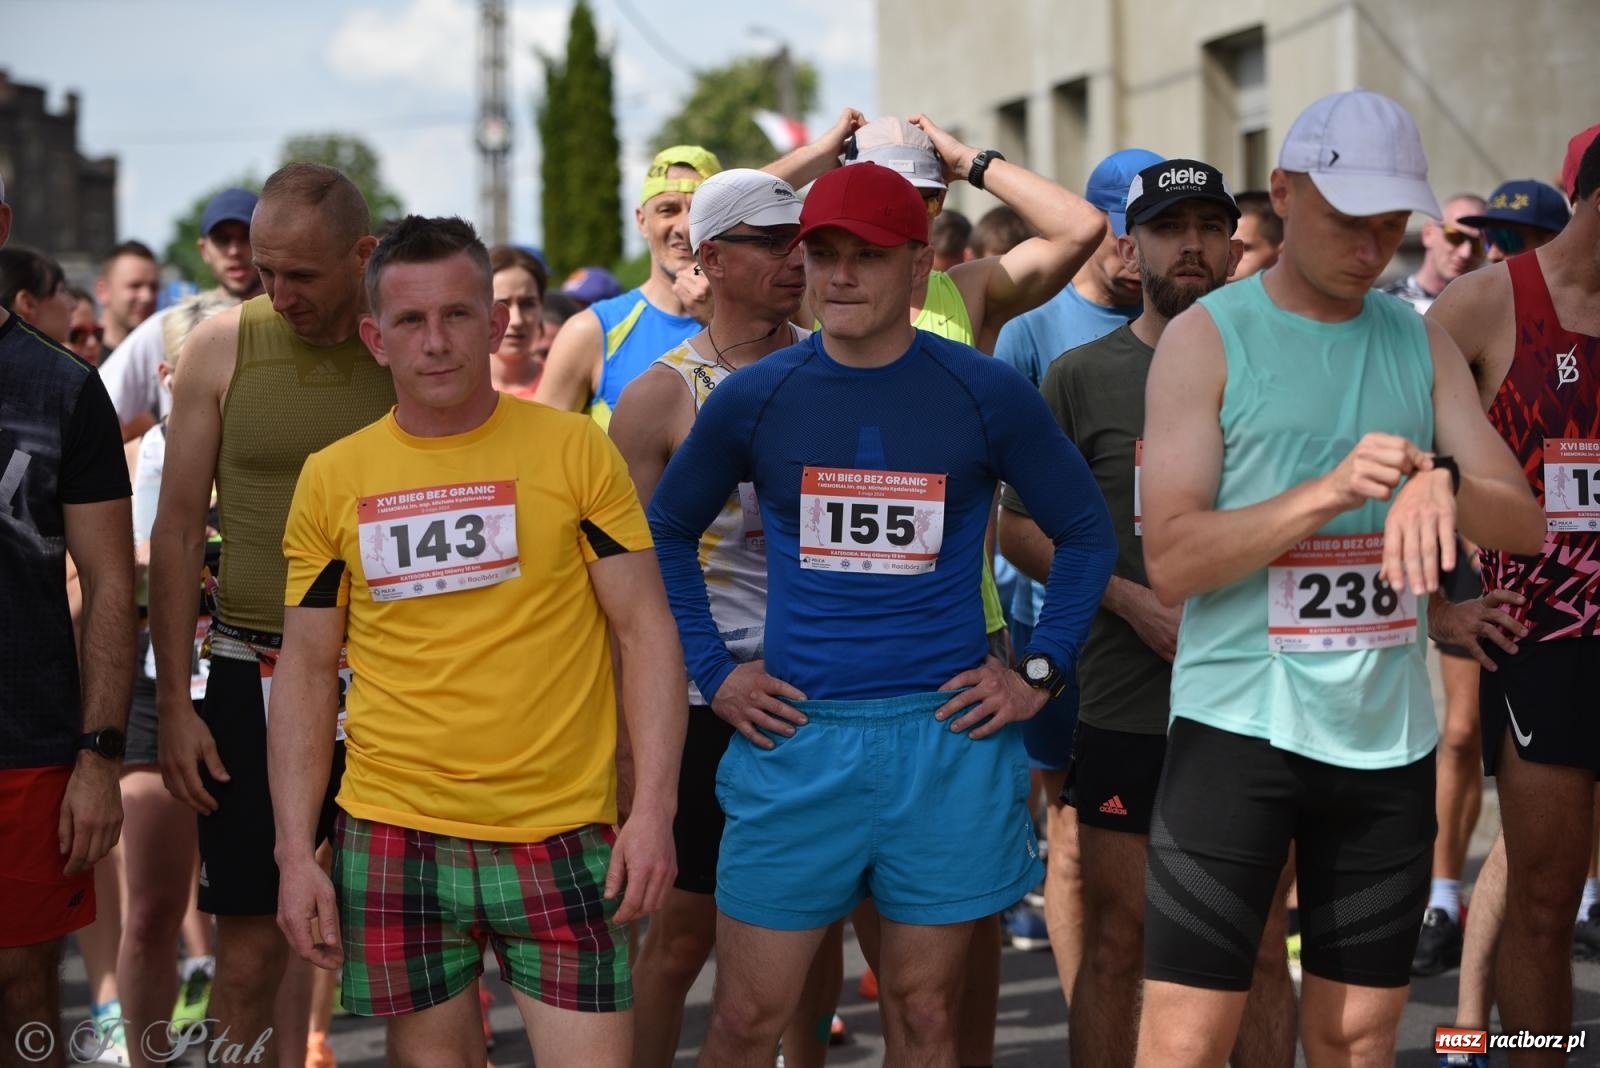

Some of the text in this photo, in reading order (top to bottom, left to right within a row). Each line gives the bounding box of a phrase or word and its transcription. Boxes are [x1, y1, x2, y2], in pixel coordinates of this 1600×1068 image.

[1158, 167, 1207, 188] ciele
[1165, 184, 1202, 192] ATHLETICS
[1560, 442, 1600, 451] XVI BIEG
[817, 472, 928, 486] XVI BIEG BEZ GRANIC
[376, 484, 496, 508] XVI BIEG BEZ GRANIC
[826, 501, 915, 546] 155
[390, 513, 487, 569] 143
[1313, 540, 1340, 551] BIEG
[1343, 539, 1364, 549] BEZ
[891, 562, 920, 570] Racibórz
[467, 572, 499, 583] Racibórz
[1298, 571, 1398, 619] 238
[1099, 806, 1128, 816] adidas
